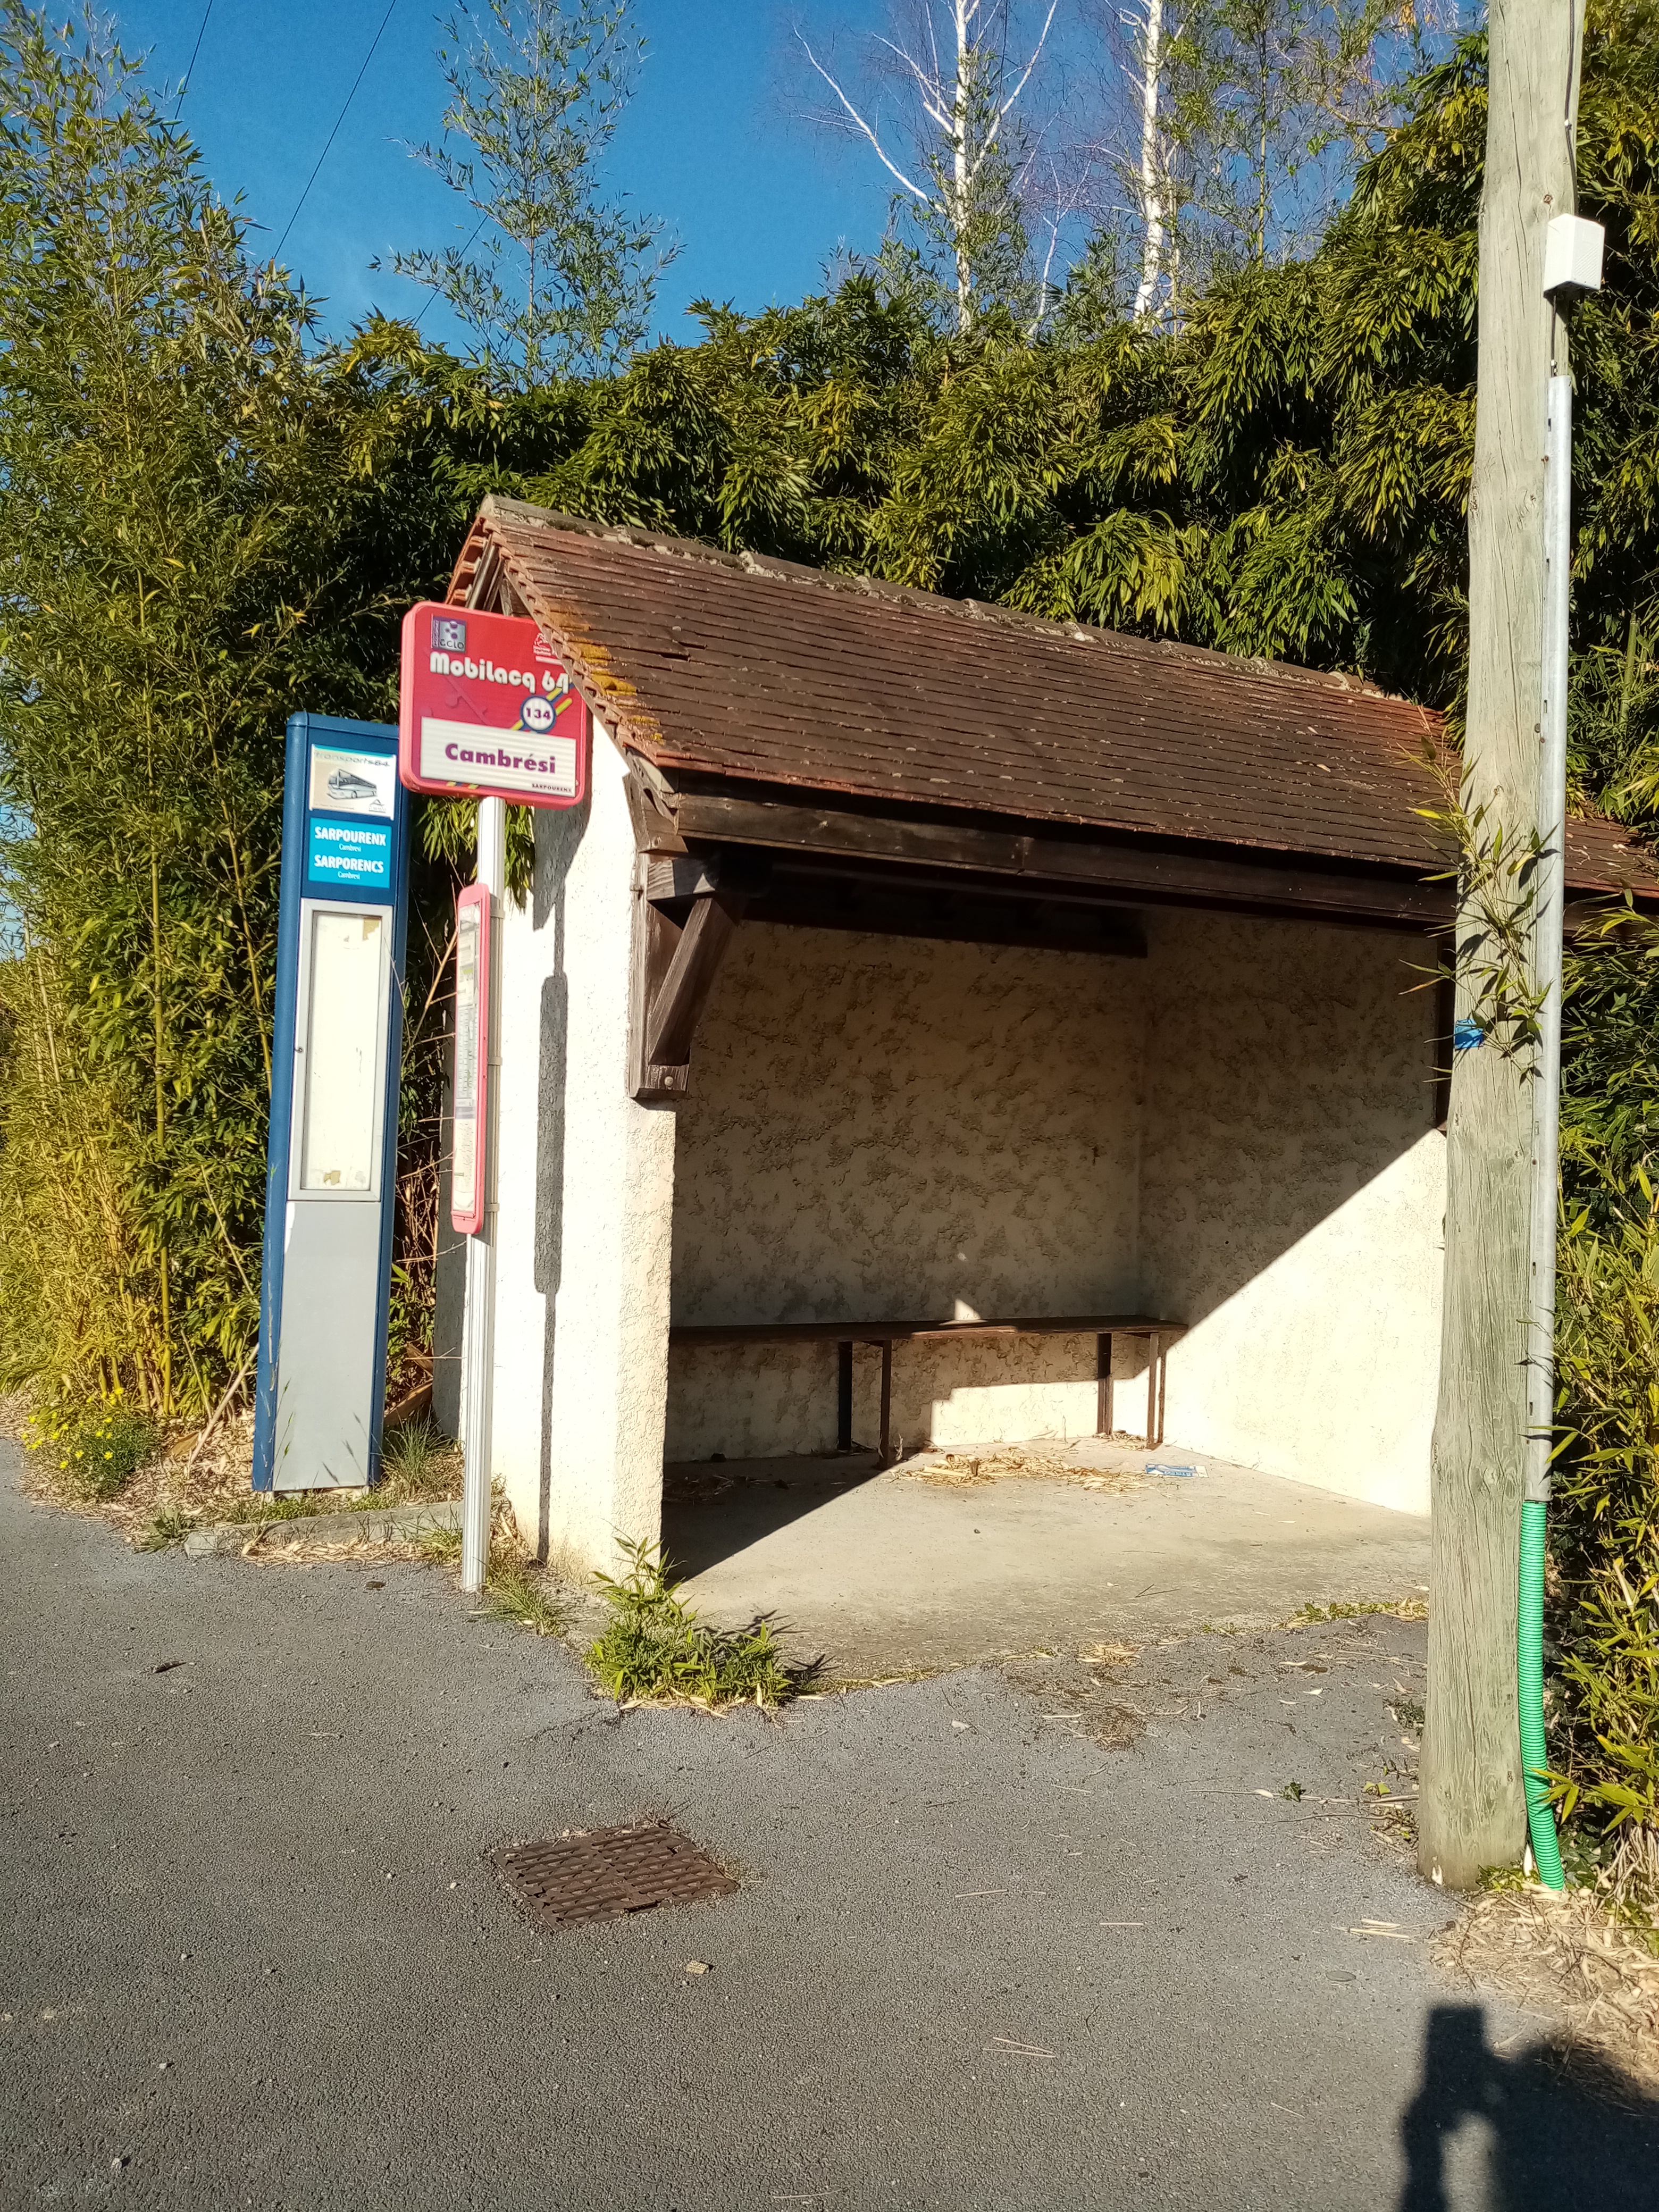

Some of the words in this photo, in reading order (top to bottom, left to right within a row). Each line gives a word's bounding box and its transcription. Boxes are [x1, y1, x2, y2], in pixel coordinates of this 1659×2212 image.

[430, 651, 535, 693] Mobilacq
[542, 669, 570, 694] 64
[525, 707, 551, 721] 134
[445, 743, 556, 774] Cambrési
[314, 826, 386, 846] SARPOURENX
[314, 854, 384, 873] SARPORENCS
